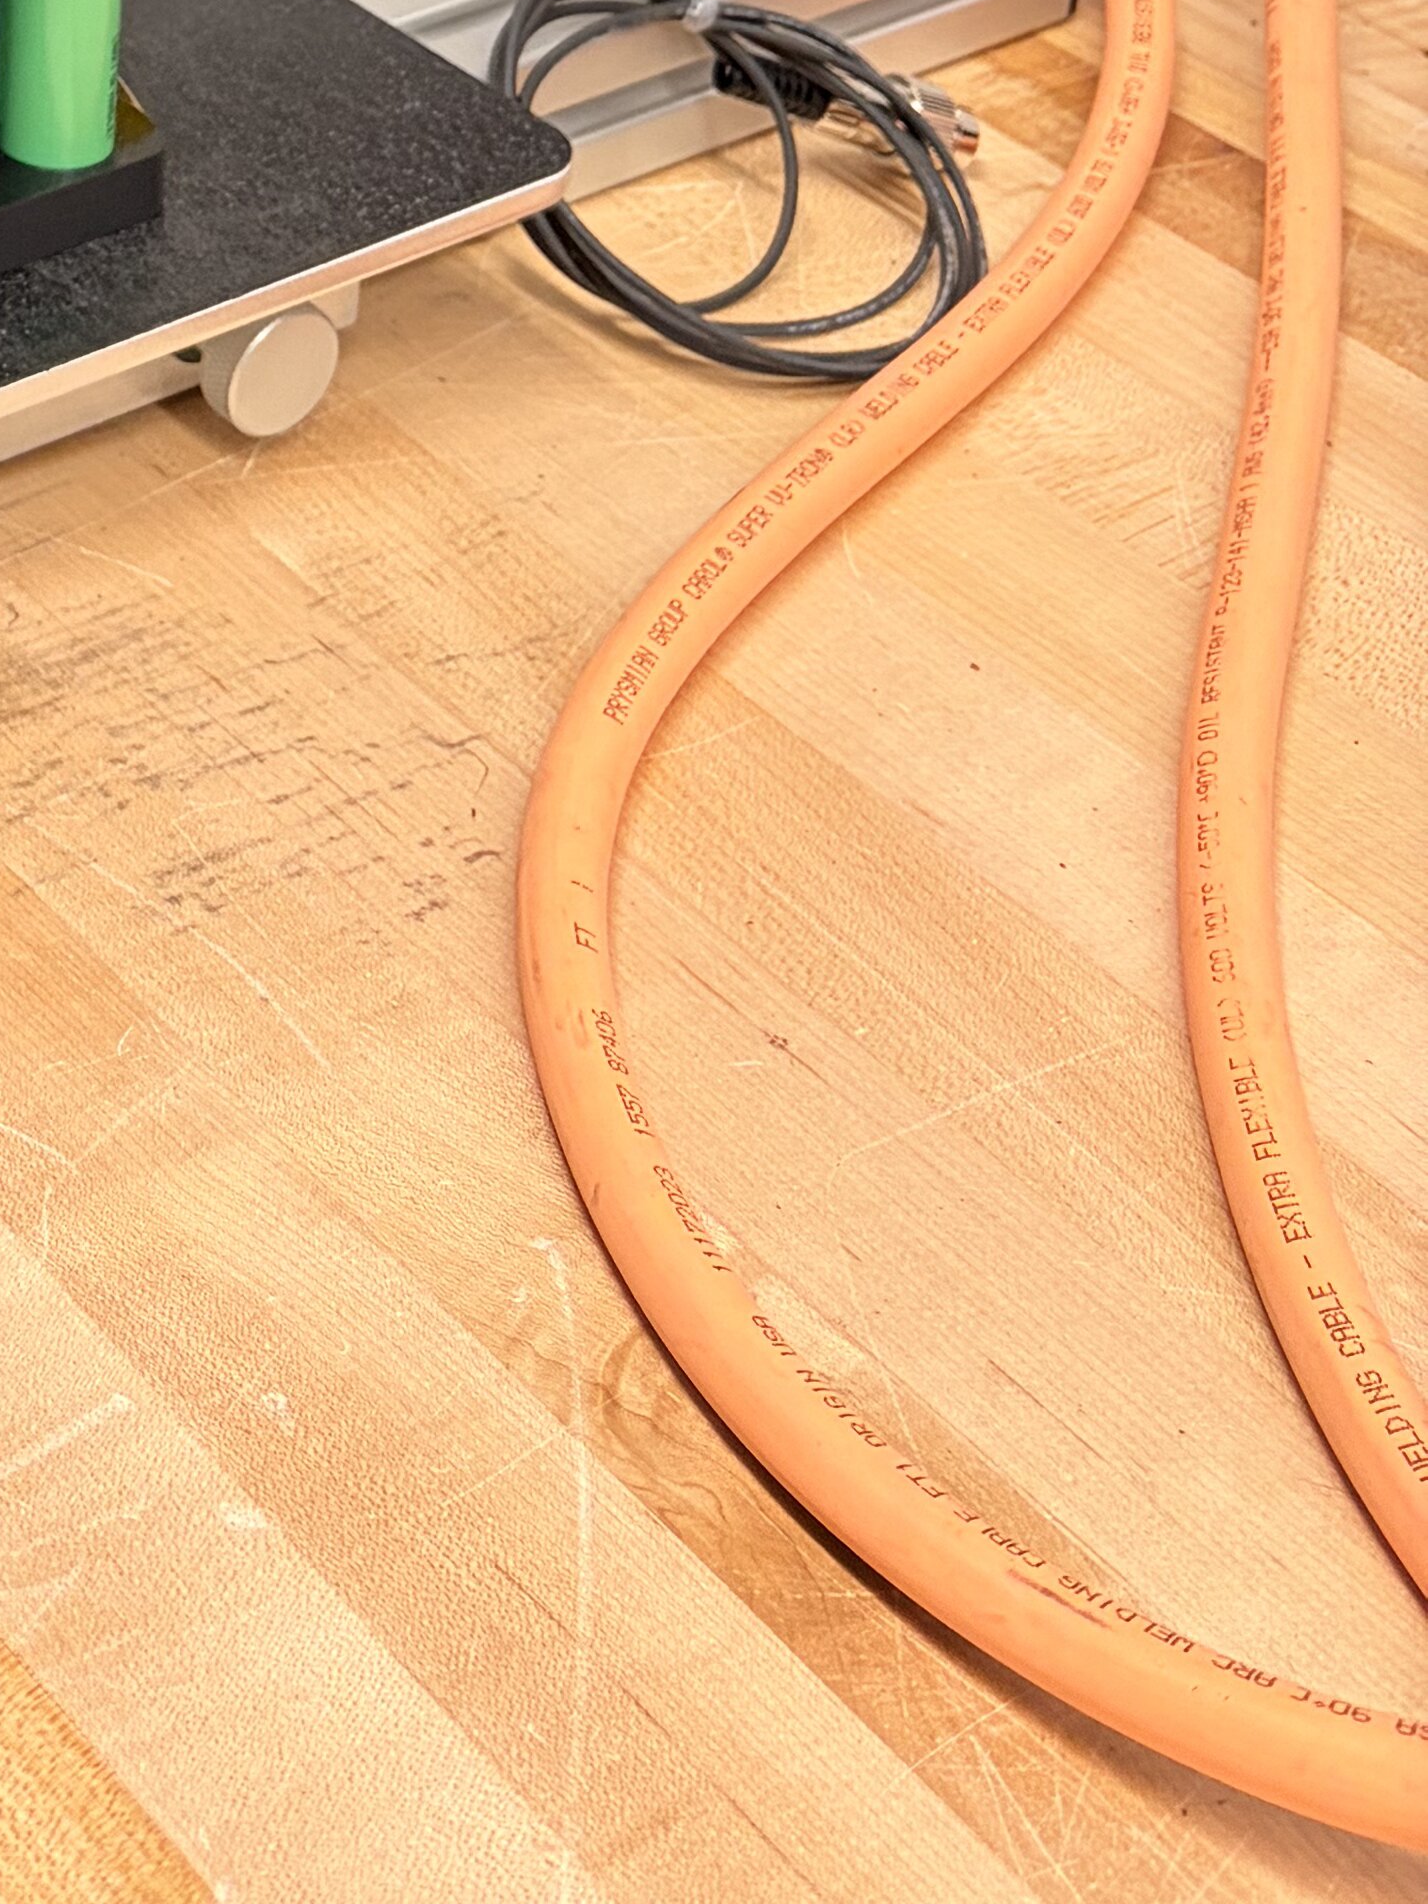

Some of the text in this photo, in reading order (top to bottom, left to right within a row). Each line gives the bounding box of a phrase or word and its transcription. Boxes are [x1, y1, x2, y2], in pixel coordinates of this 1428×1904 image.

[602, 645, 659, 726] PRYSMIAN
[647, 598, 689, 647] GROUP
[727, 504, 774, 548] SUPER
[913, 340, 960, 376] CABLE
[1197, 712, 1219, 742] OIL
[1228, 1056, 1281, 1161] FLEXIBLE
[1262, 1171, 1312, 1244] EXTRA
[752, 1314, 797, 1356] USA
[1307, 1282, 1365, 1357] CABLE
[796, 1368, 888, 1448] ORIGIN
[1058, 1575, 1195, 1653] WELDING
[1211, 1654, 1278, 1687] ARC
[1290, 1689, 1372, 1724] 90°C
